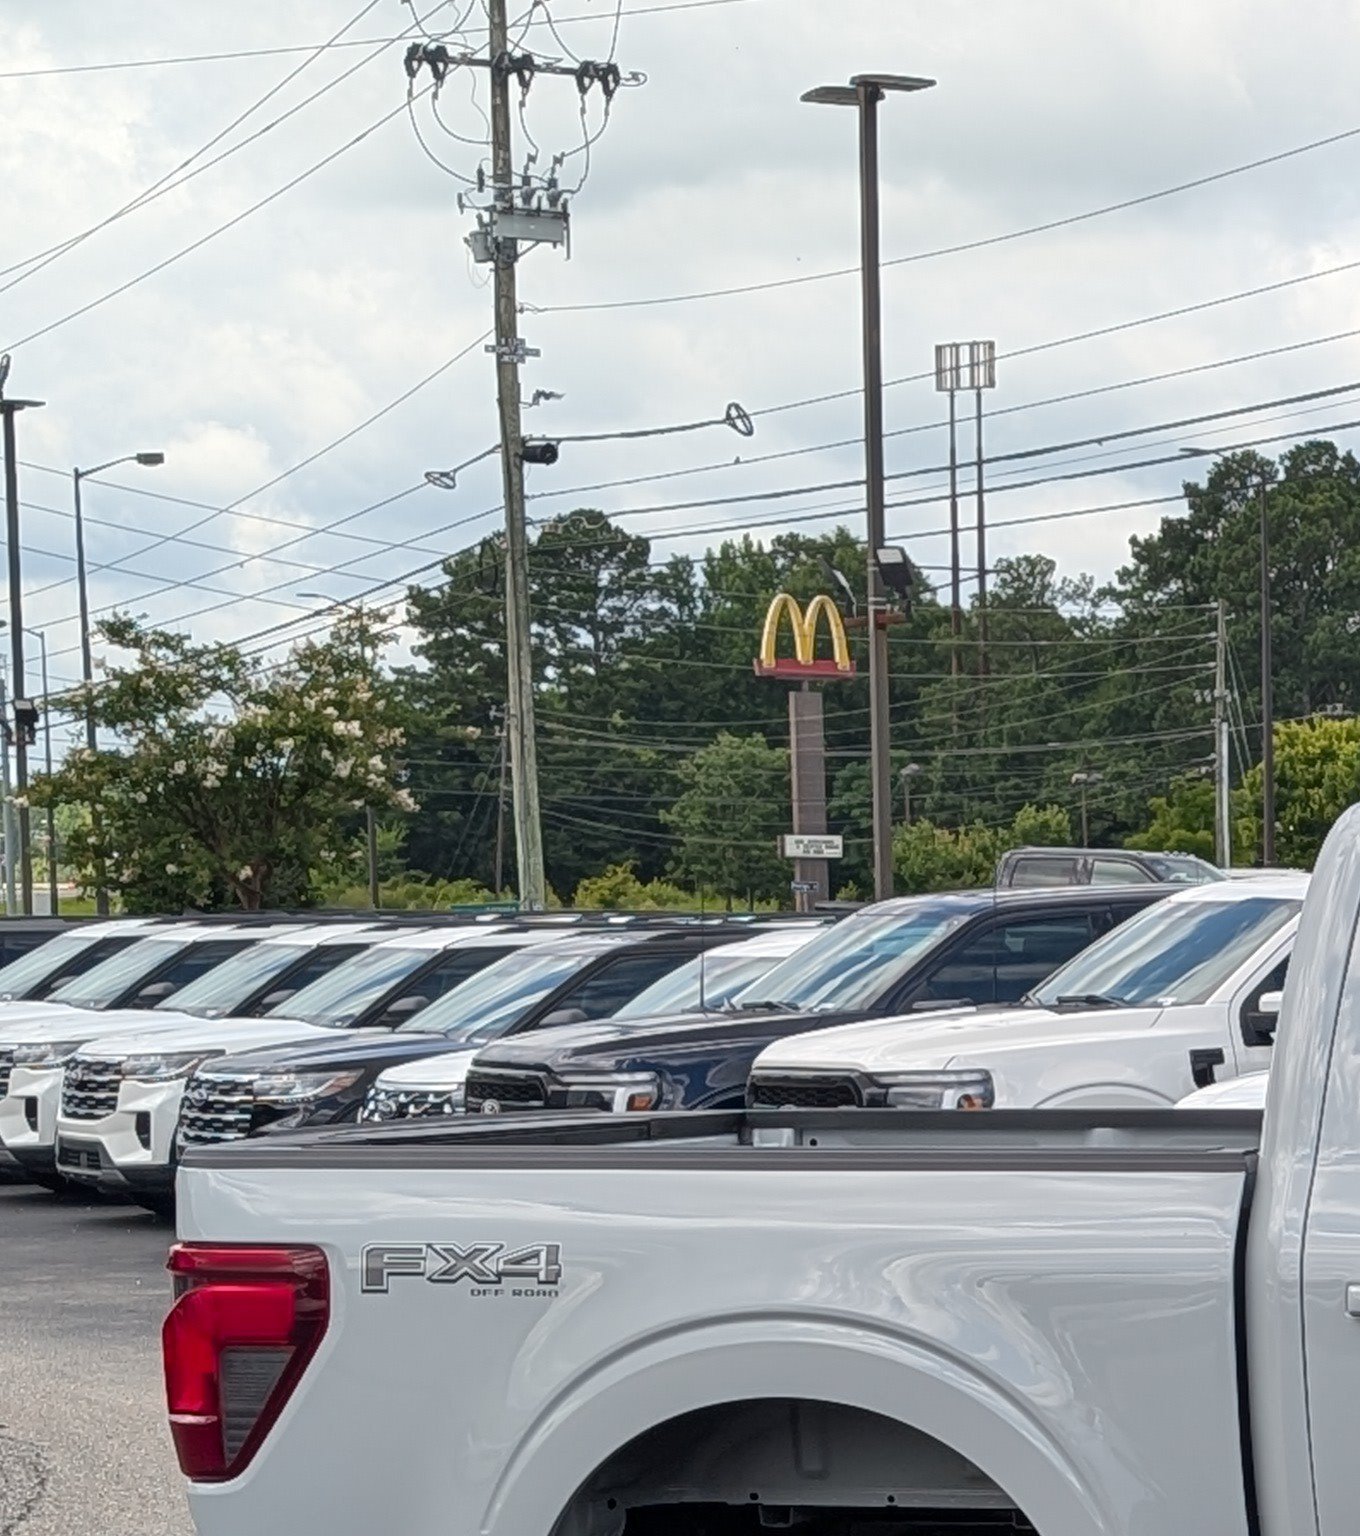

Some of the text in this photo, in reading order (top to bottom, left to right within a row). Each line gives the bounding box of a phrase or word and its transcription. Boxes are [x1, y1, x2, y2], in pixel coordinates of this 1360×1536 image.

[361, 1242, 562, 1294] FX4
[470, 1288, 559, 1297] OFF ROAD
